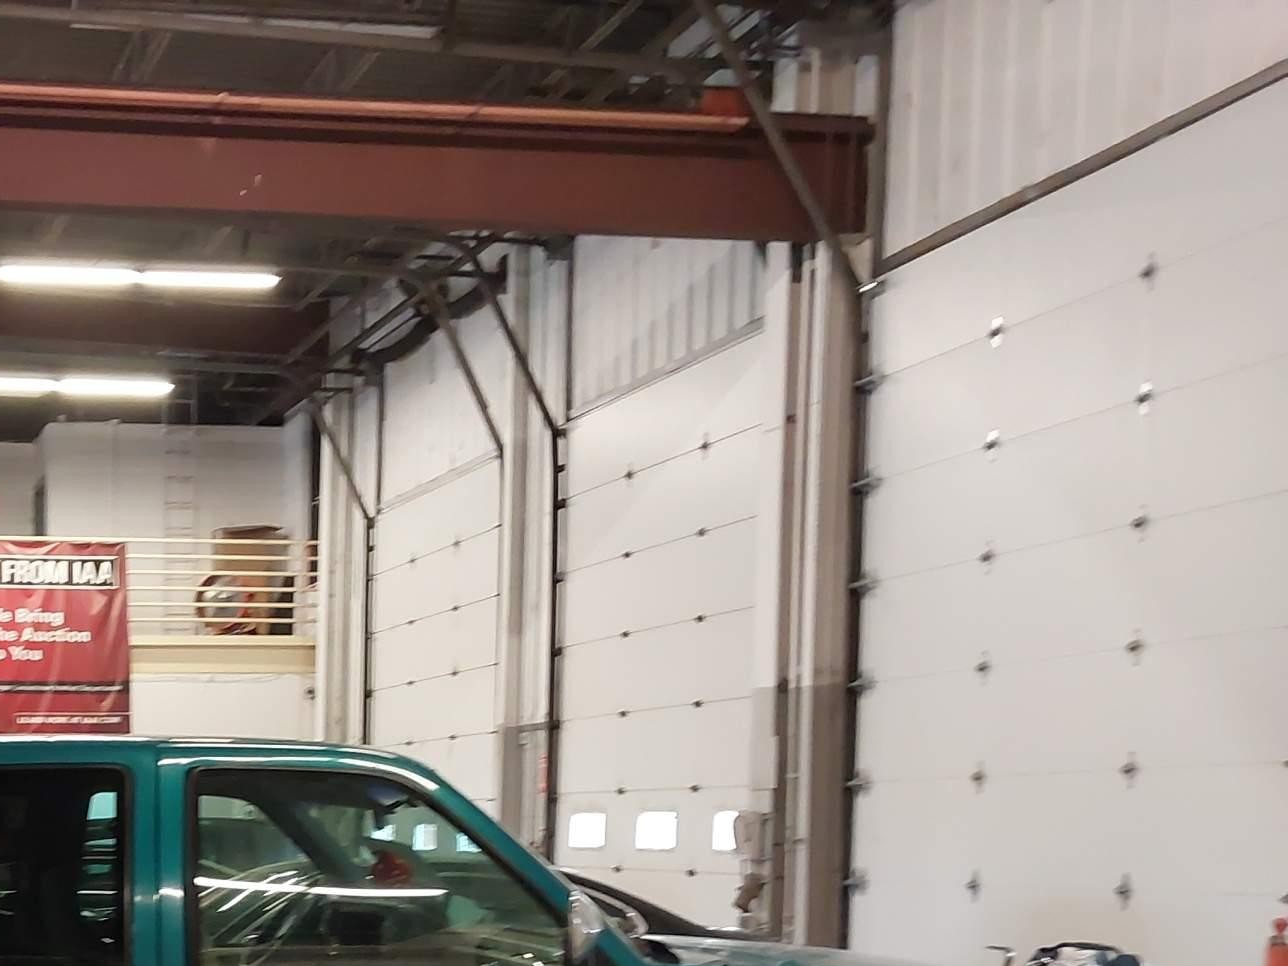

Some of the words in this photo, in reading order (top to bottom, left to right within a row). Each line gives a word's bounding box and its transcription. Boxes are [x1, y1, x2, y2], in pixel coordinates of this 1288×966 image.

[1, 560, 69, 584] FROM
[72, 560, 113, 584] IAA
[14, 607, 65, 626] Bring
[20, 627, 92, 642] Auction
[8, 645, 43, 660] You
